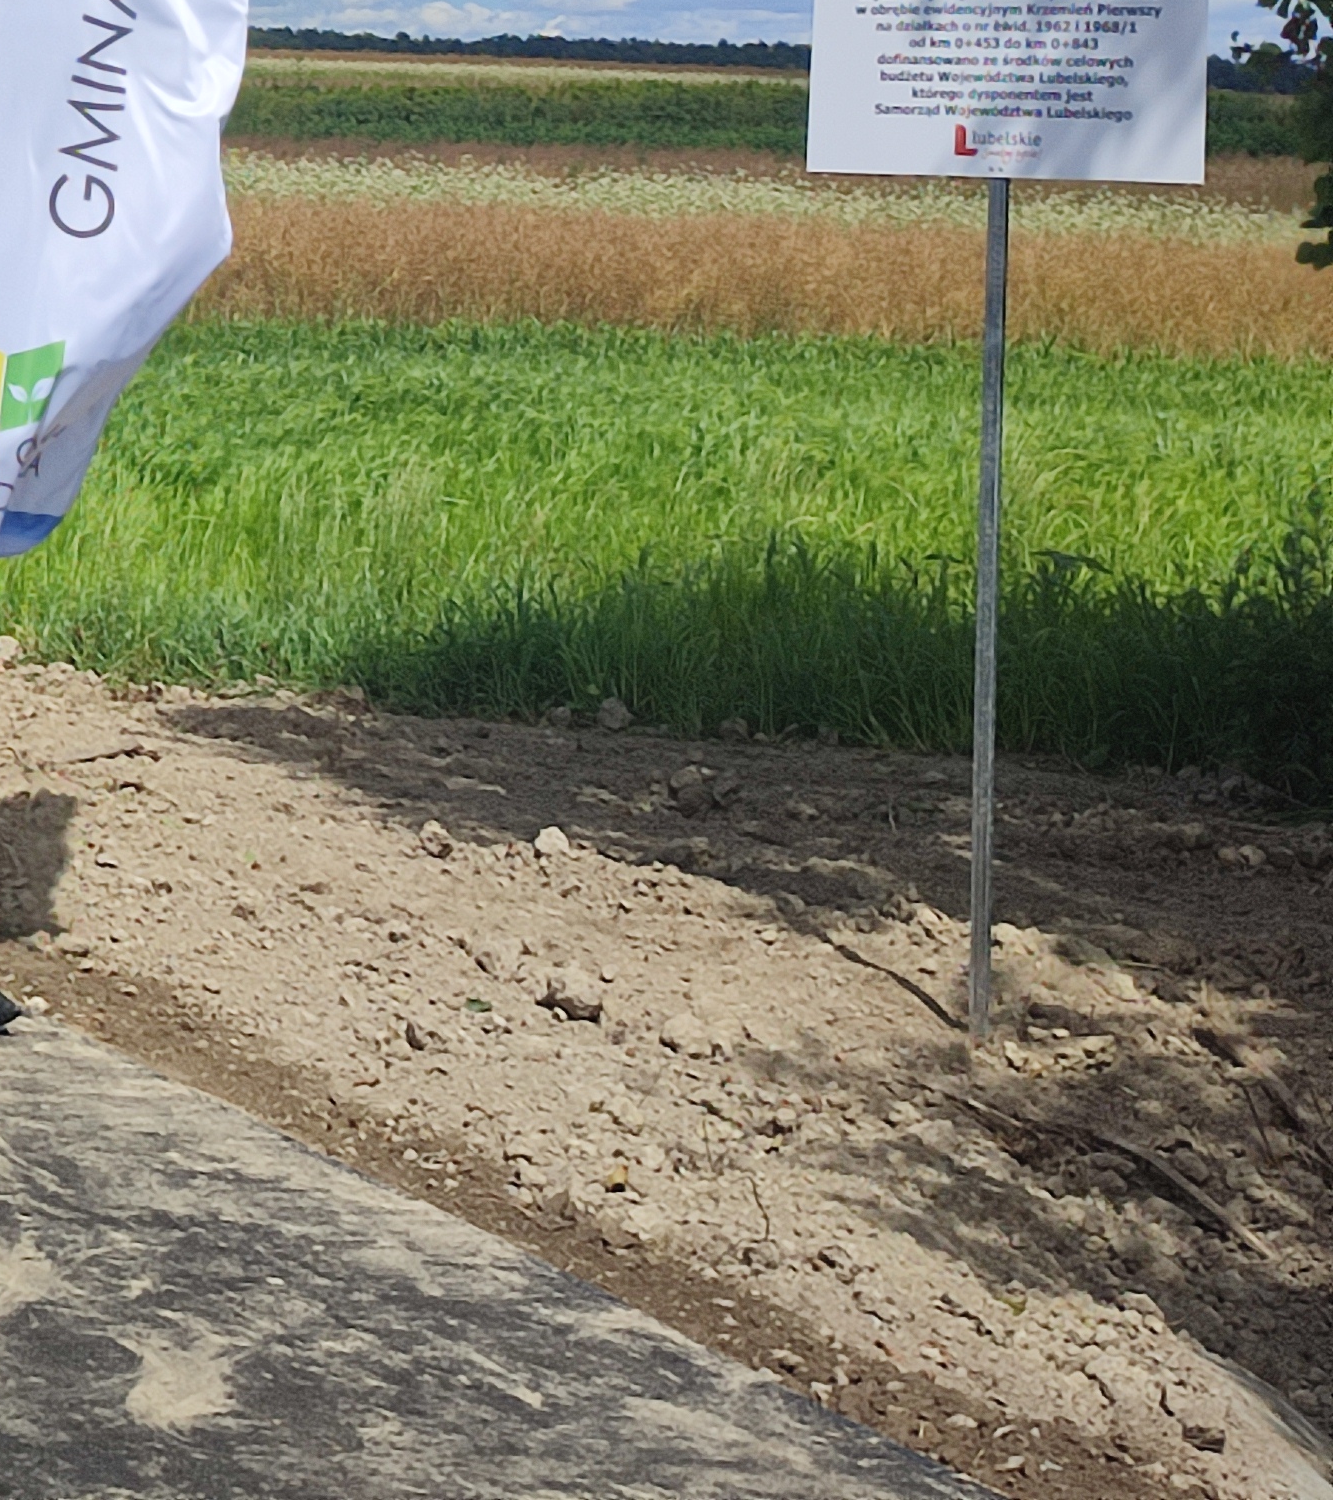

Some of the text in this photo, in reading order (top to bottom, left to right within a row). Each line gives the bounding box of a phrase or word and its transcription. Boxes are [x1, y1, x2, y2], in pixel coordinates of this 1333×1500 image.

[855, 6, 867, 15] w
[870, 3, 921, 17] obrębie
[923, 3, 1023, 18] ewidencyjnym
[1097, 3, 1162, 19] Pierwszy
[875, 21, 892, 32] na
[895, 19, 959, 32] działkach
[962, 21, 971, 32] o
[974, 21, 990, 32] nr
[1035, 20, 1071, 33] 1962
[908, 36, 926, 48] od
[929, 36, 951, 48] km
[954, 37, 1000, 49] 0+453
[1004, 37, 1022, 49] do
[1025, 37, 1047, 49] km
[876, 53, 1134, 70] dofinansowano ze środków celowych
[880, 69, 1129, 88] budżetu Województwa Lubelskiego,
[911, 86, 1093, 104] którego dysponentem jest
[874, 103, 1134, 123] Samorząd Województwa Lubelskiego
[972, 130, 1043, 147] lubelskie
